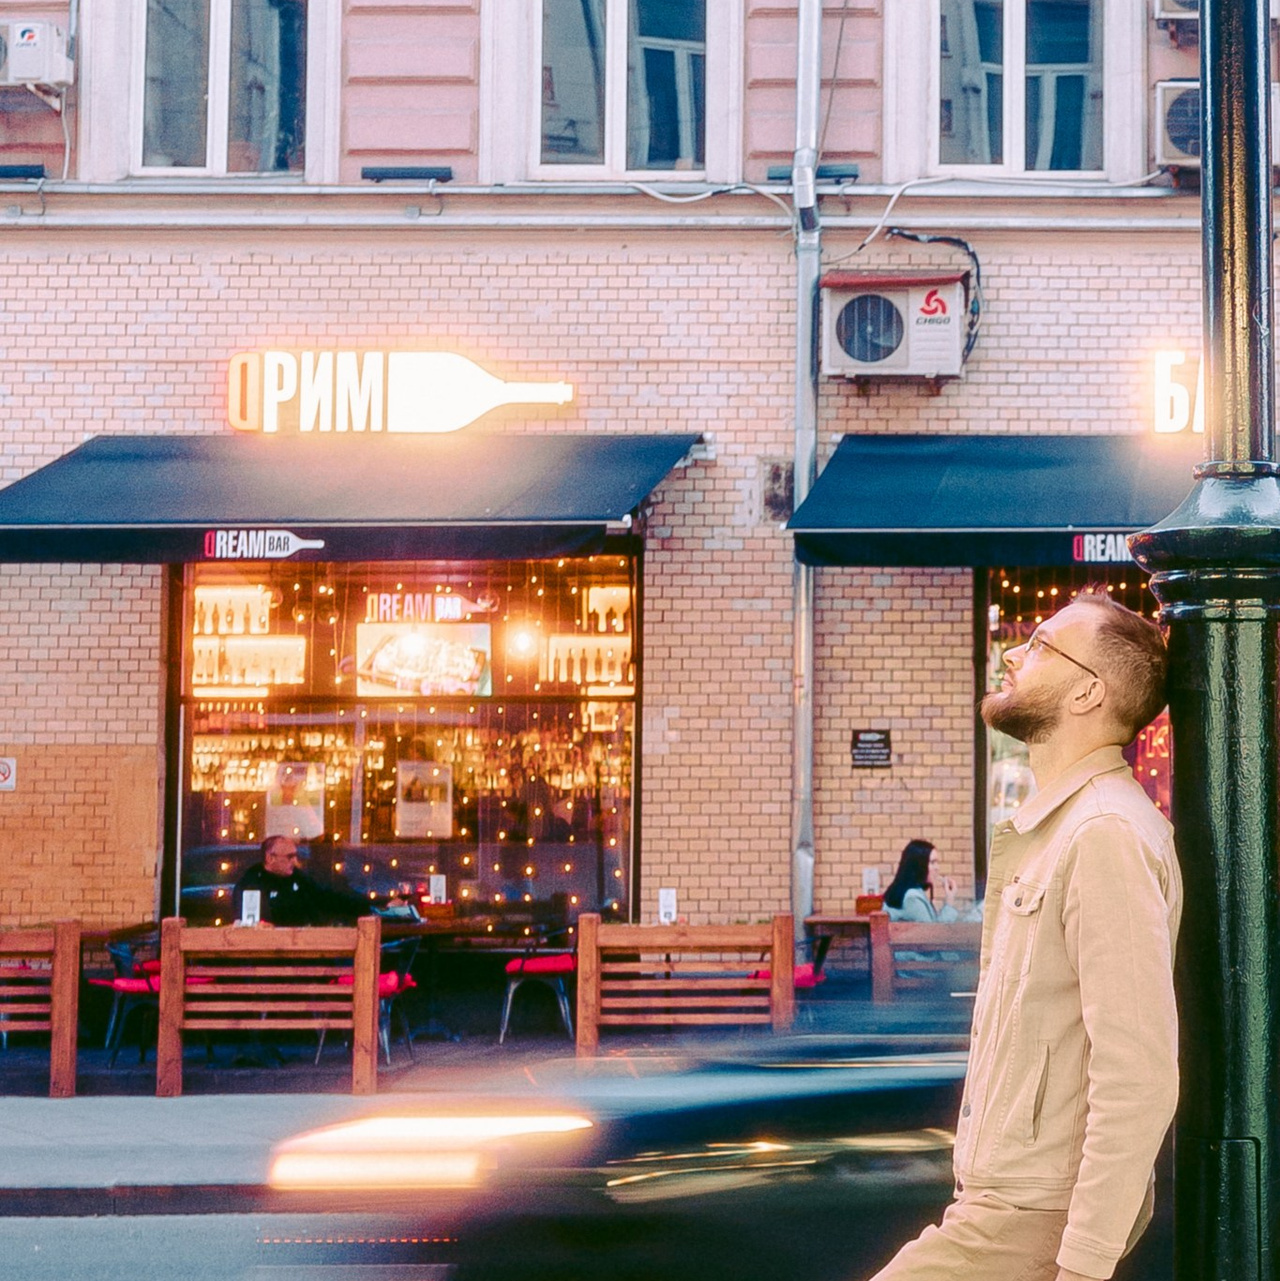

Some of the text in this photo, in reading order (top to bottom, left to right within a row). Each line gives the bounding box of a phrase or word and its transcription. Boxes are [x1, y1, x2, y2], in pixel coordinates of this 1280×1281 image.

[204, 529, 290, 559] DREAM BAR
[366, 592, 432, 622] DREAM
